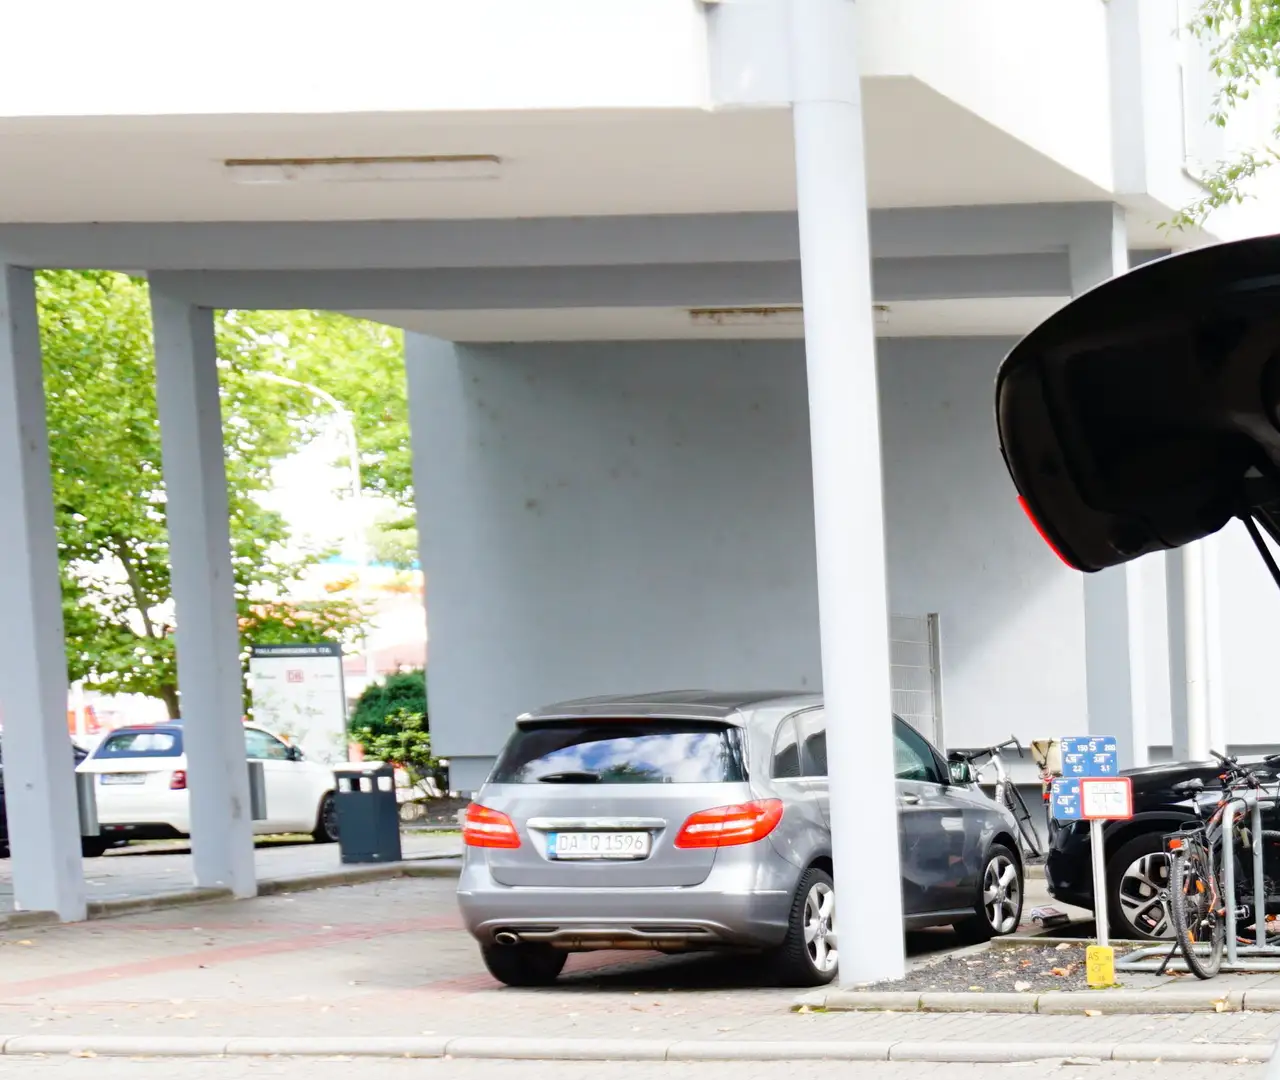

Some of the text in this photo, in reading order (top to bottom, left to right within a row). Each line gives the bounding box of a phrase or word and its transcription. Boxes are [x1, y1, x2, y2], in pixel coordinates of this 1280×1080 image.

[1061, 742, 1069, 752] S
[1089, 741, 1097, 751] S
[1053, 784, 1060, 793] S
[559, 835, 578, 850] DA
[605, 835, 644, 850] 1596
